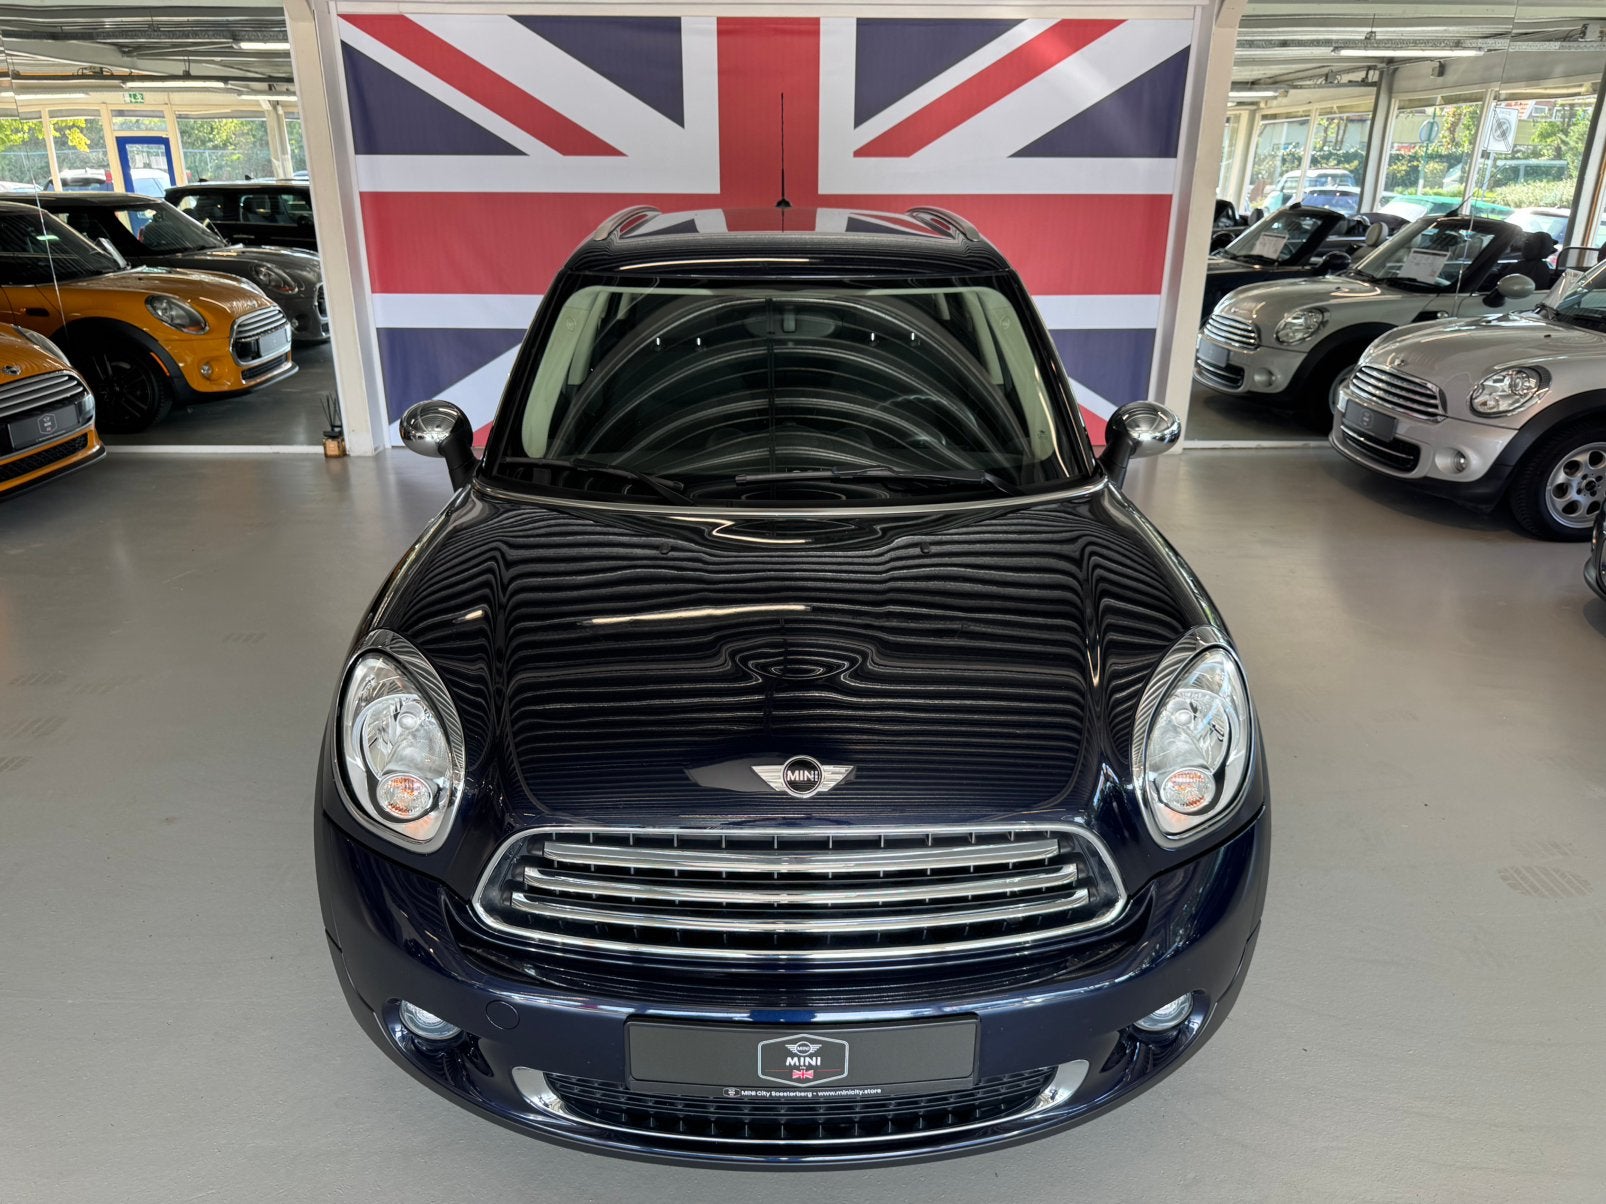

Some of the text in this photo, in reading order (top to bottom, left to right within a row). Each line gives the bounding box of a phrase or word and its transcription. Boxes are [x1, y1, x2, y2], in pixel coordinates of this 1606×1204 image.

[787, 770, 819, 782] MINI
[785, 1056, 821, 1066] MINI
[757, 1090, 770, 1098] City
[817, 1088, 882, 1097] www.minicity.store
